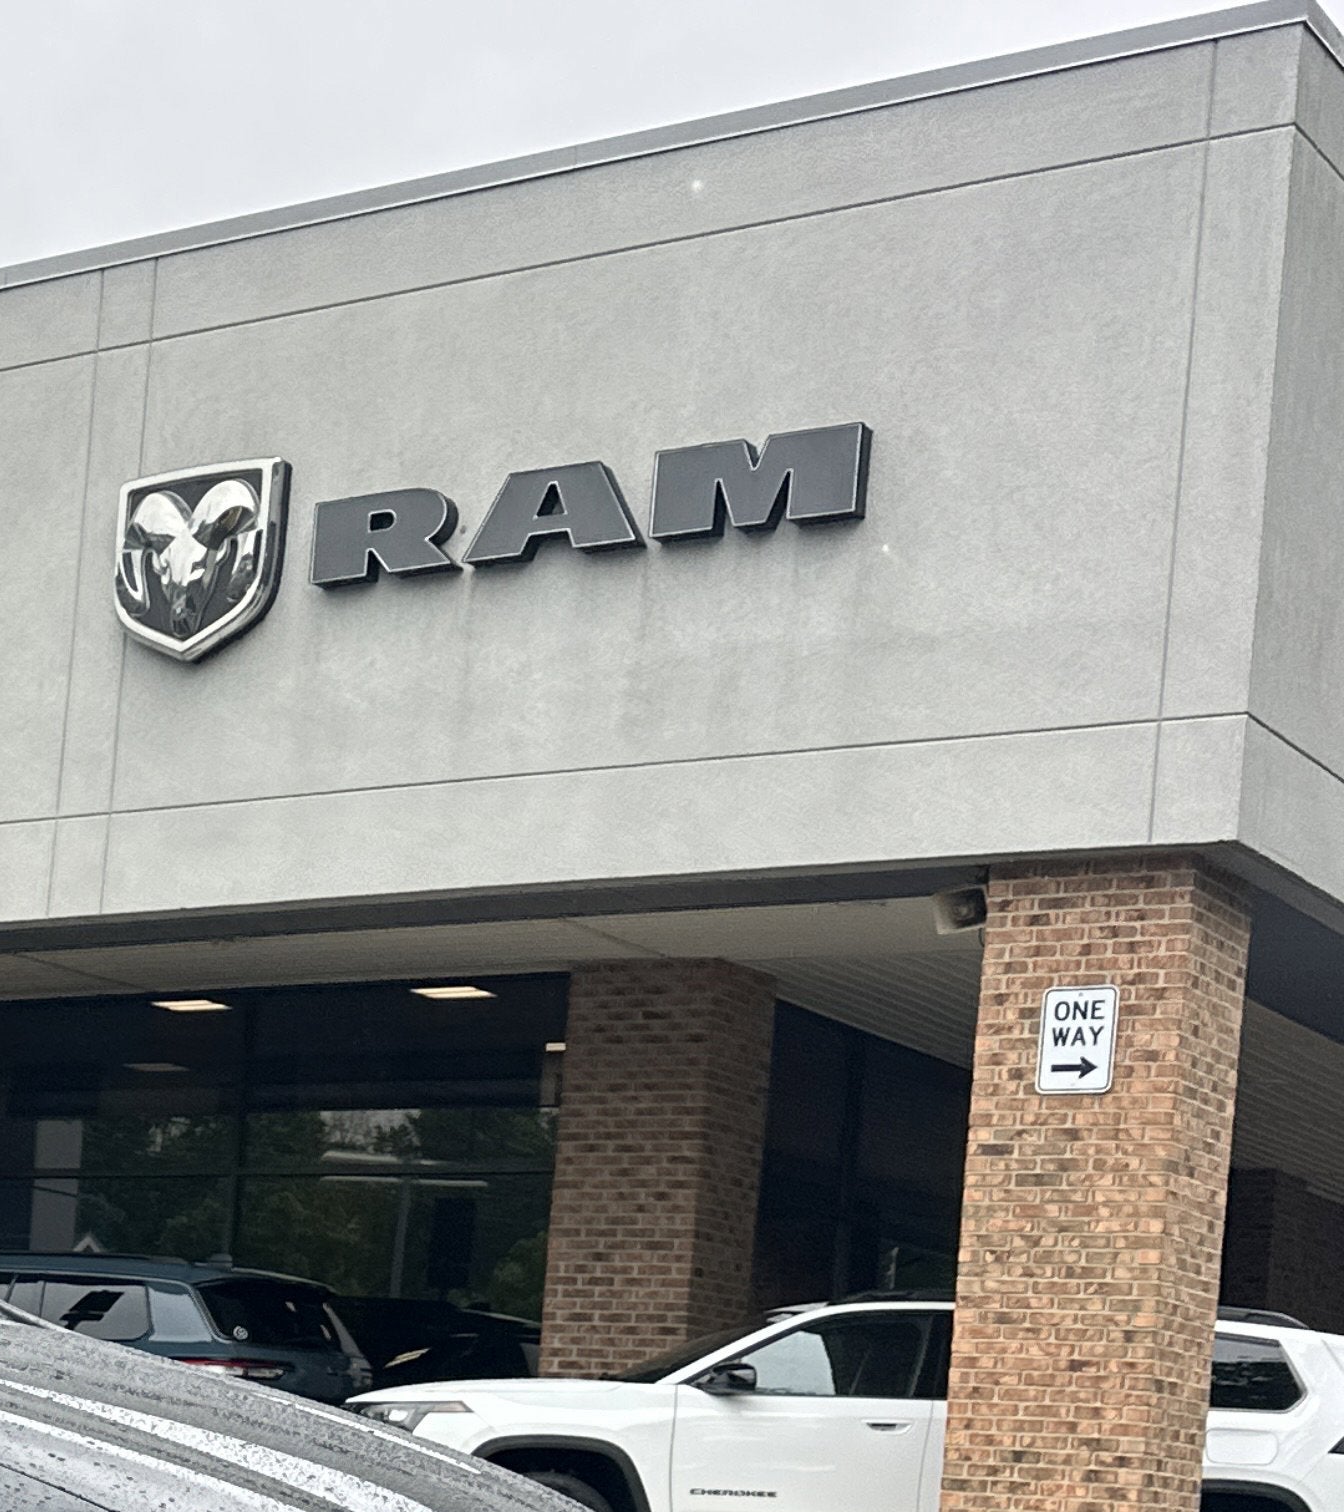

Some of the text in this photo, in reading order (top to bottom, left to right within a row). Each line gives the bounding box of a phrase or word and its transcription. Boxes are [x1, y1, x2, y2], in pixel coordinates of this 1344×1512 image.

[309, 421, 873, 591] RAM
[1054, 999, 1105, 1021] ONE
[1052, 1026, 1105, 1047] WAY
[689, 1488, 777, 1498] CHEROKEE
